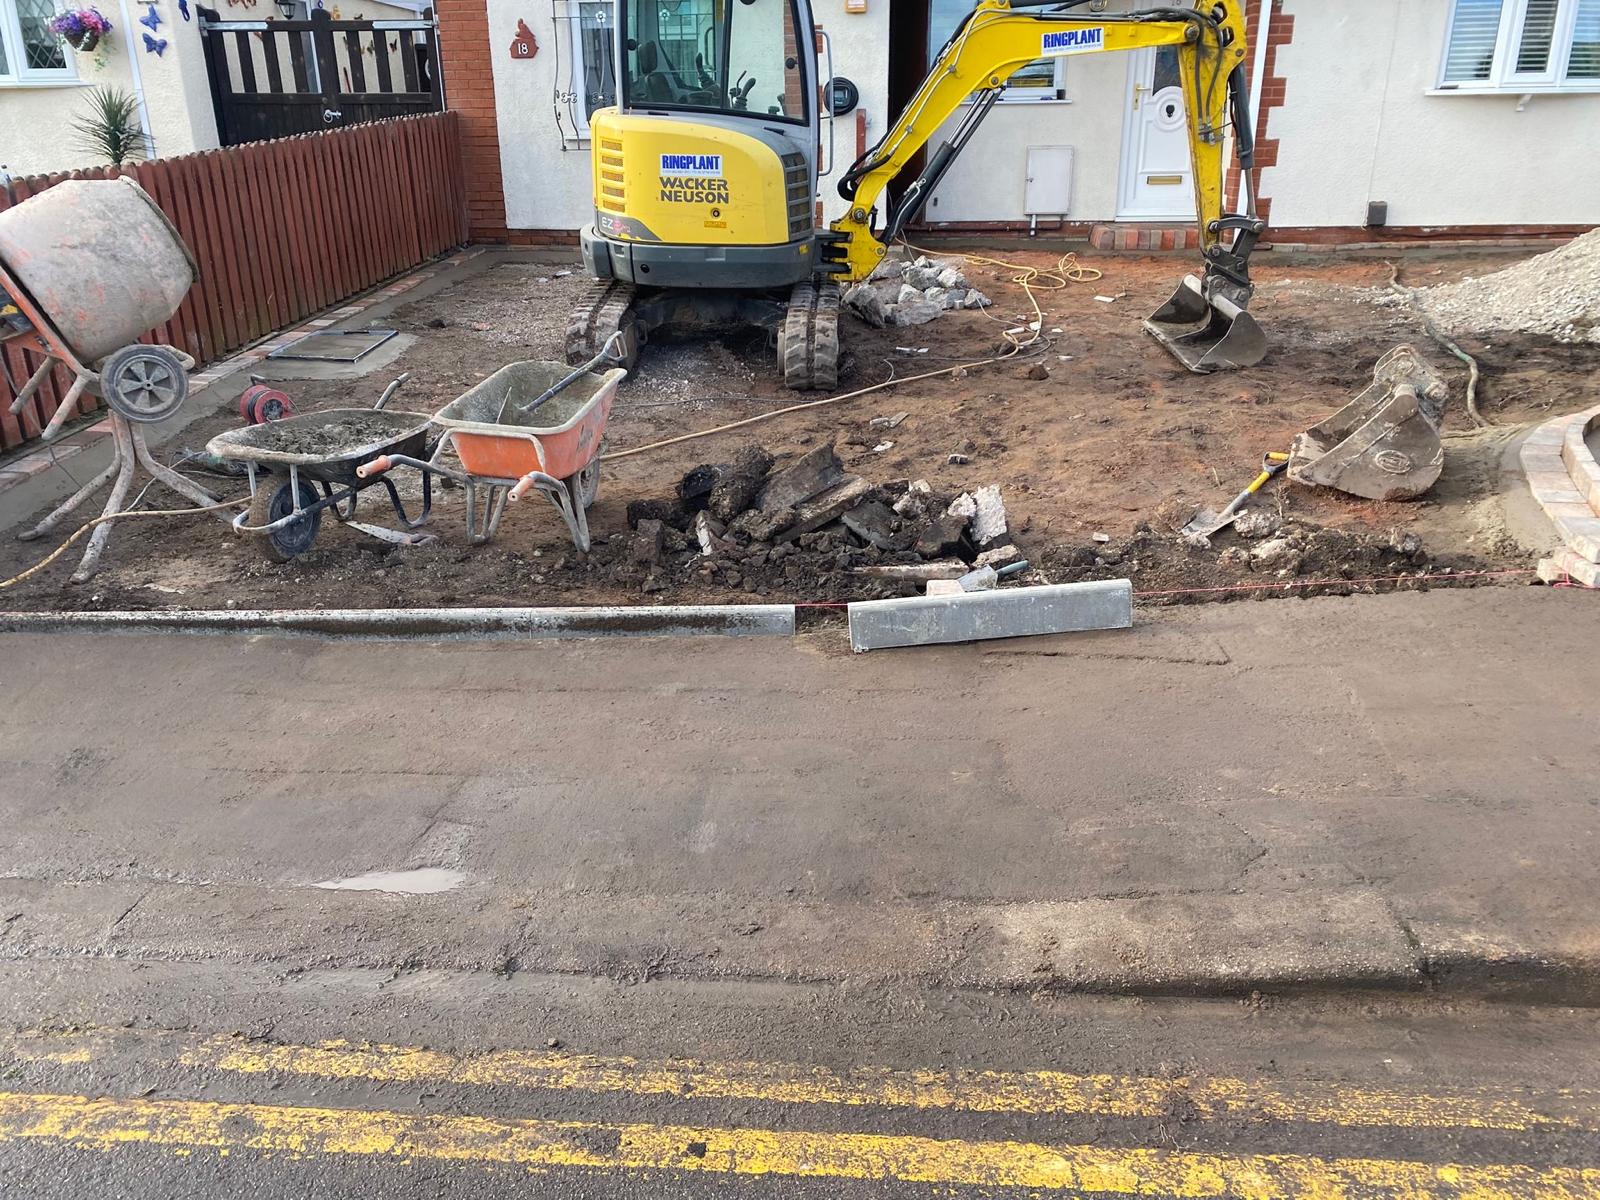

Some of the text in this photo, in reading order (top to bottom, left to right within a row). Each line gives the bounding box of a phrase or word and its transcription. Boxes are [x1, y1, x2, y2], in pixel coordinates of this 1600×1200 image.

[1043, 28, 1101, 48] RINGPLANT
[517, 43, 528, 54] 18
[662, 155, 720, 169] RINGPLANT
[659, 177, 728, 191] WACKER
[660, 190, 729, 204] NEUSON
